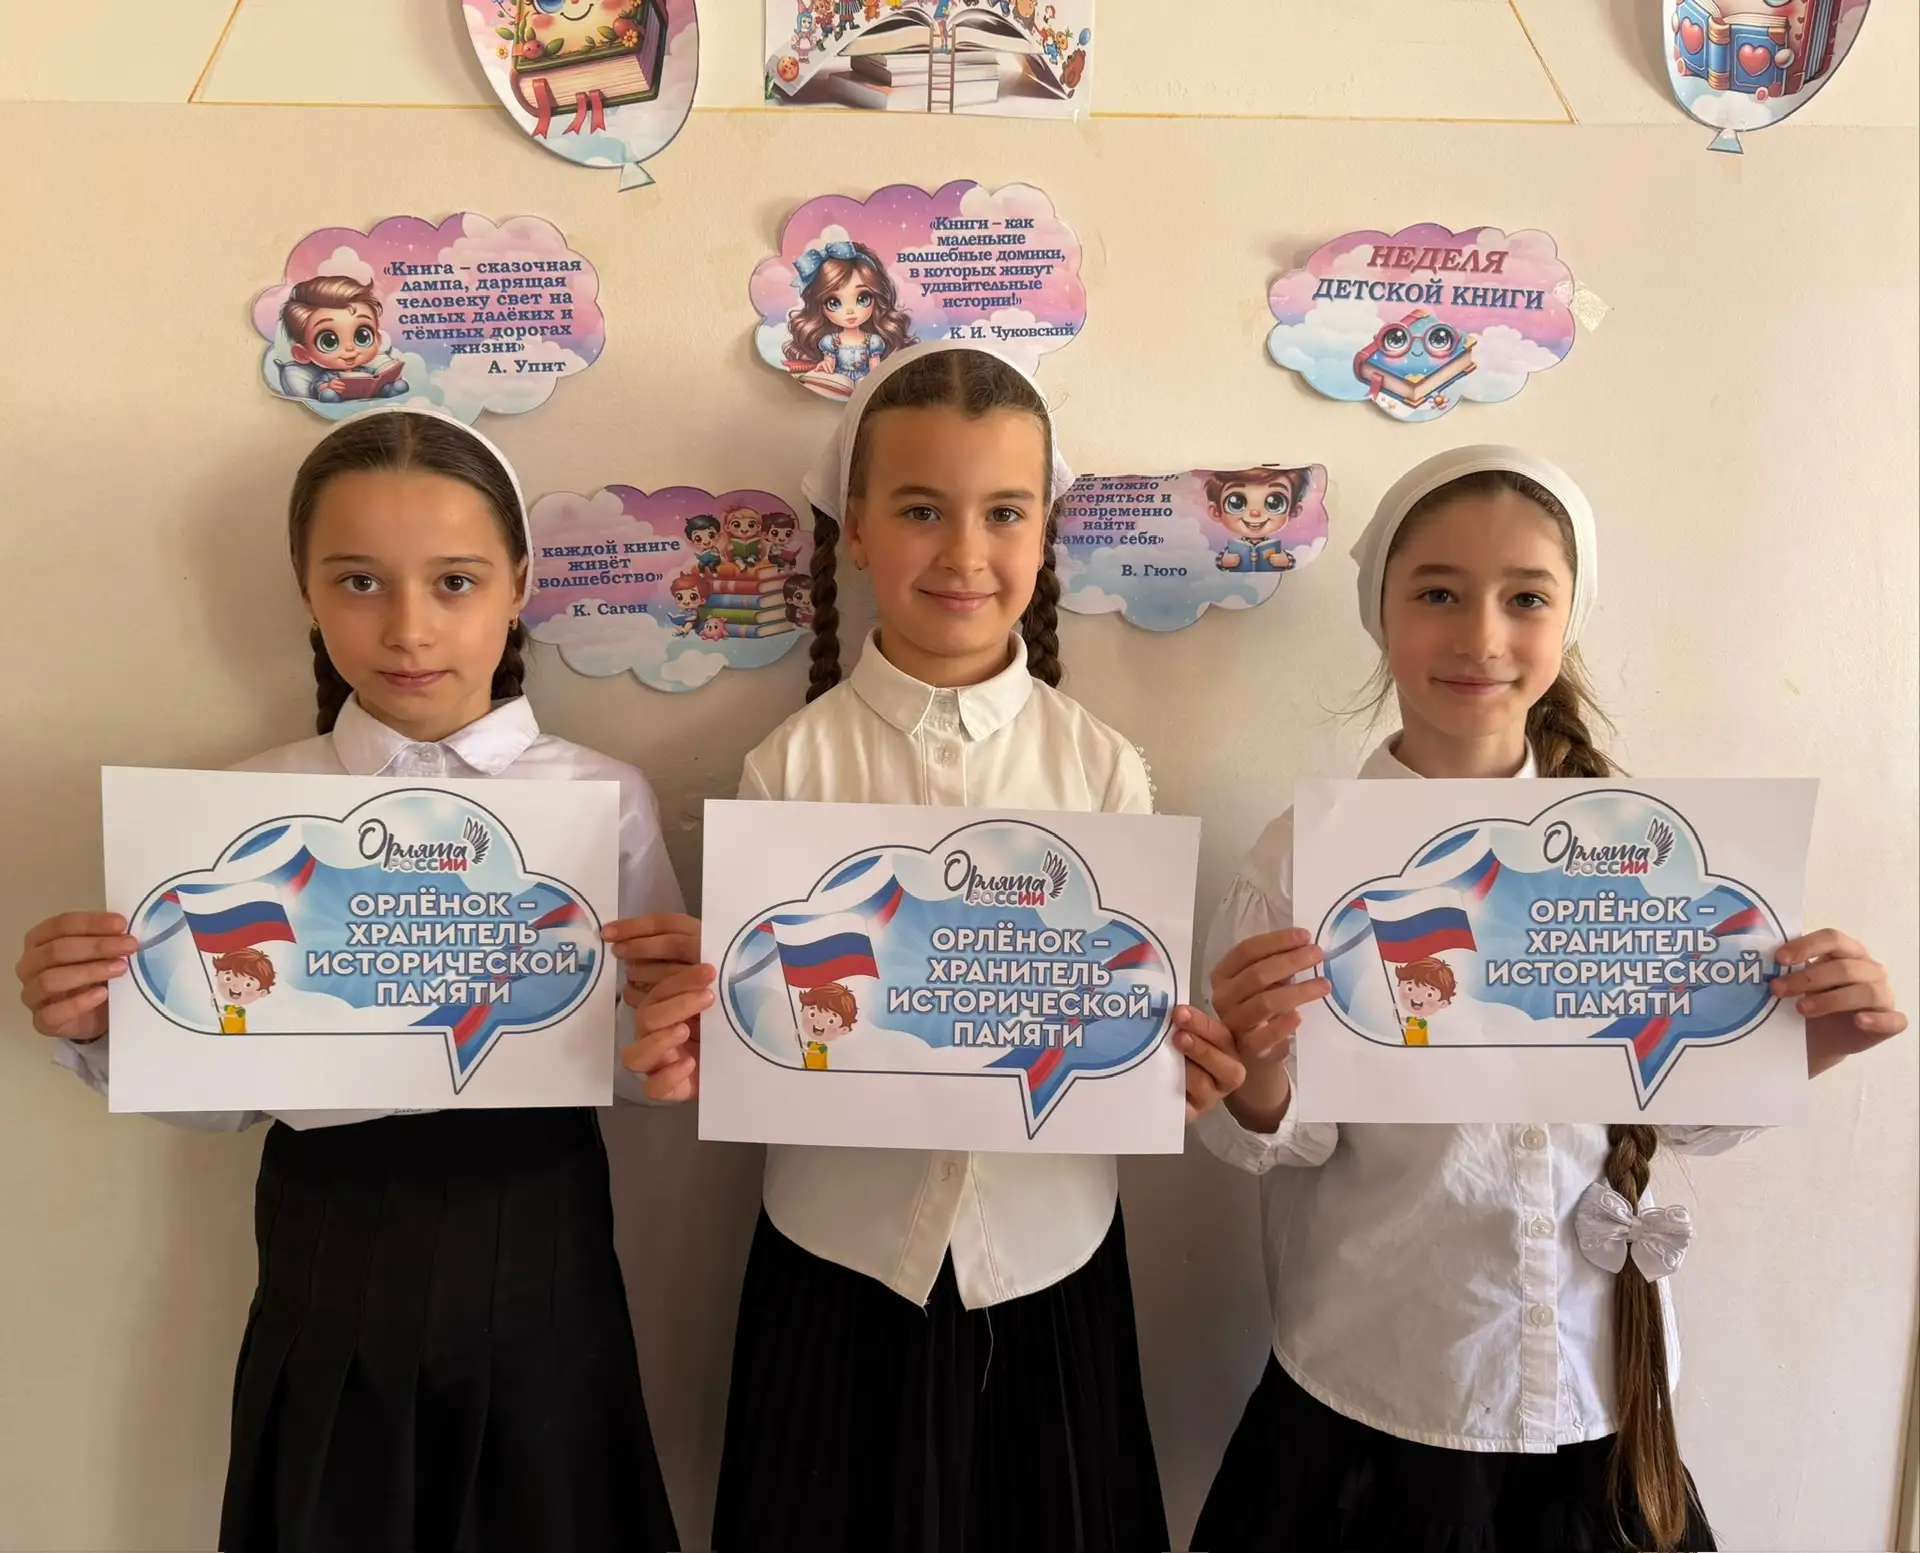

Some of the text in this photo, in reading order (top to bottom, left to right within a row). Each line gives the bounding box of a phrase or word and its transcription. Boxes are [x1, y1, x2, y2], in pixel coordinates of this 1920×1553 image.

[930, 217, 988, 230] «Книги
[1004, 218, 1034, 229] как
[937, 233, 1026, 246] маленькие
[897, 248, 1065, 263] волшебные домики,
[1367, 245, 1508, 275] НЕДЕЛЯ
[384, 262, 454, 276] «Книга
[477, 260, 581, 274] сказочная
[910, 264, 1053, 280] в которых живут
[401, 276, 567, 293] лампа, дарящая
[921, 279, 1042, 296] удивительные
[396, 293, 573, 310] человеку свет на
[943, 293, 1022, 310] истории!»
[1312, 277, 1545, 310] ДЕТСКОЙ КНИГИ
[398, 308, 573, 325] самых далёких и
[402, 324, 572, 340] тёмных дорогах
[950, 323, 1075, 339] К. И. Чуковский
[451, 342, 525, 355] жизни»
[488, 359, 566, 374] А. Упит
[1100, 481, 1159, 490] можно
[1063, 493, 1171, 506] отеряться и
[1062, 507, 1172, 520] новременно
[1083, 518, 1135, 530] найти
[1120, 532, 1164, 545] себя»
[542, 540, 618, 558] каждой
[623, 540, 680, 554] книге
[568, 556, 631, 571] живёт
[1121, 565, 1187, 576] В. Гюго
[538, 571, 663, 588] волшебство»
[573, 603, 648, 617] К. Саган
[358, 818, 468, 868] Орлята
[1543, 821, 1650, 872] Орлята
[387, 858, 467, 871] РОССИИ
[1570, 861, 1648, 874] РОССИИ
[944, 850, 1046, 901] Орлята
[349, 887, 510, 917] ОРЛЁНОК
[969, 890, 1044, 906] РОССИИ
[1530, 892, 1688, 924] ОРЛЁНОК
[348, 923, 538, 945] ХРАНИТЕЛЬ
[930, 922, 1085, 955] ОРЛЁНОК
[1527, 929, 1720, 954] ХРАНИТЕЛЬ
[307, 944, 577, 975] ИСТОРИЧЕСКОЙ
[1487, 951, 1762, 985] ИСТОРИЧЕСКОЙ
[927, 960, 1112, 986] ХРАНИТЕЛЬ
[376, 982, 510, 1005] ПАМЯТИ
[887, 987, 1151, 1018] ИСТОРИЧЕСКОЙ
[1556, 991, 1692, 1016] ПАМЯТИ
[953, 1022, 1085, 1048] ПАМЯТИ
